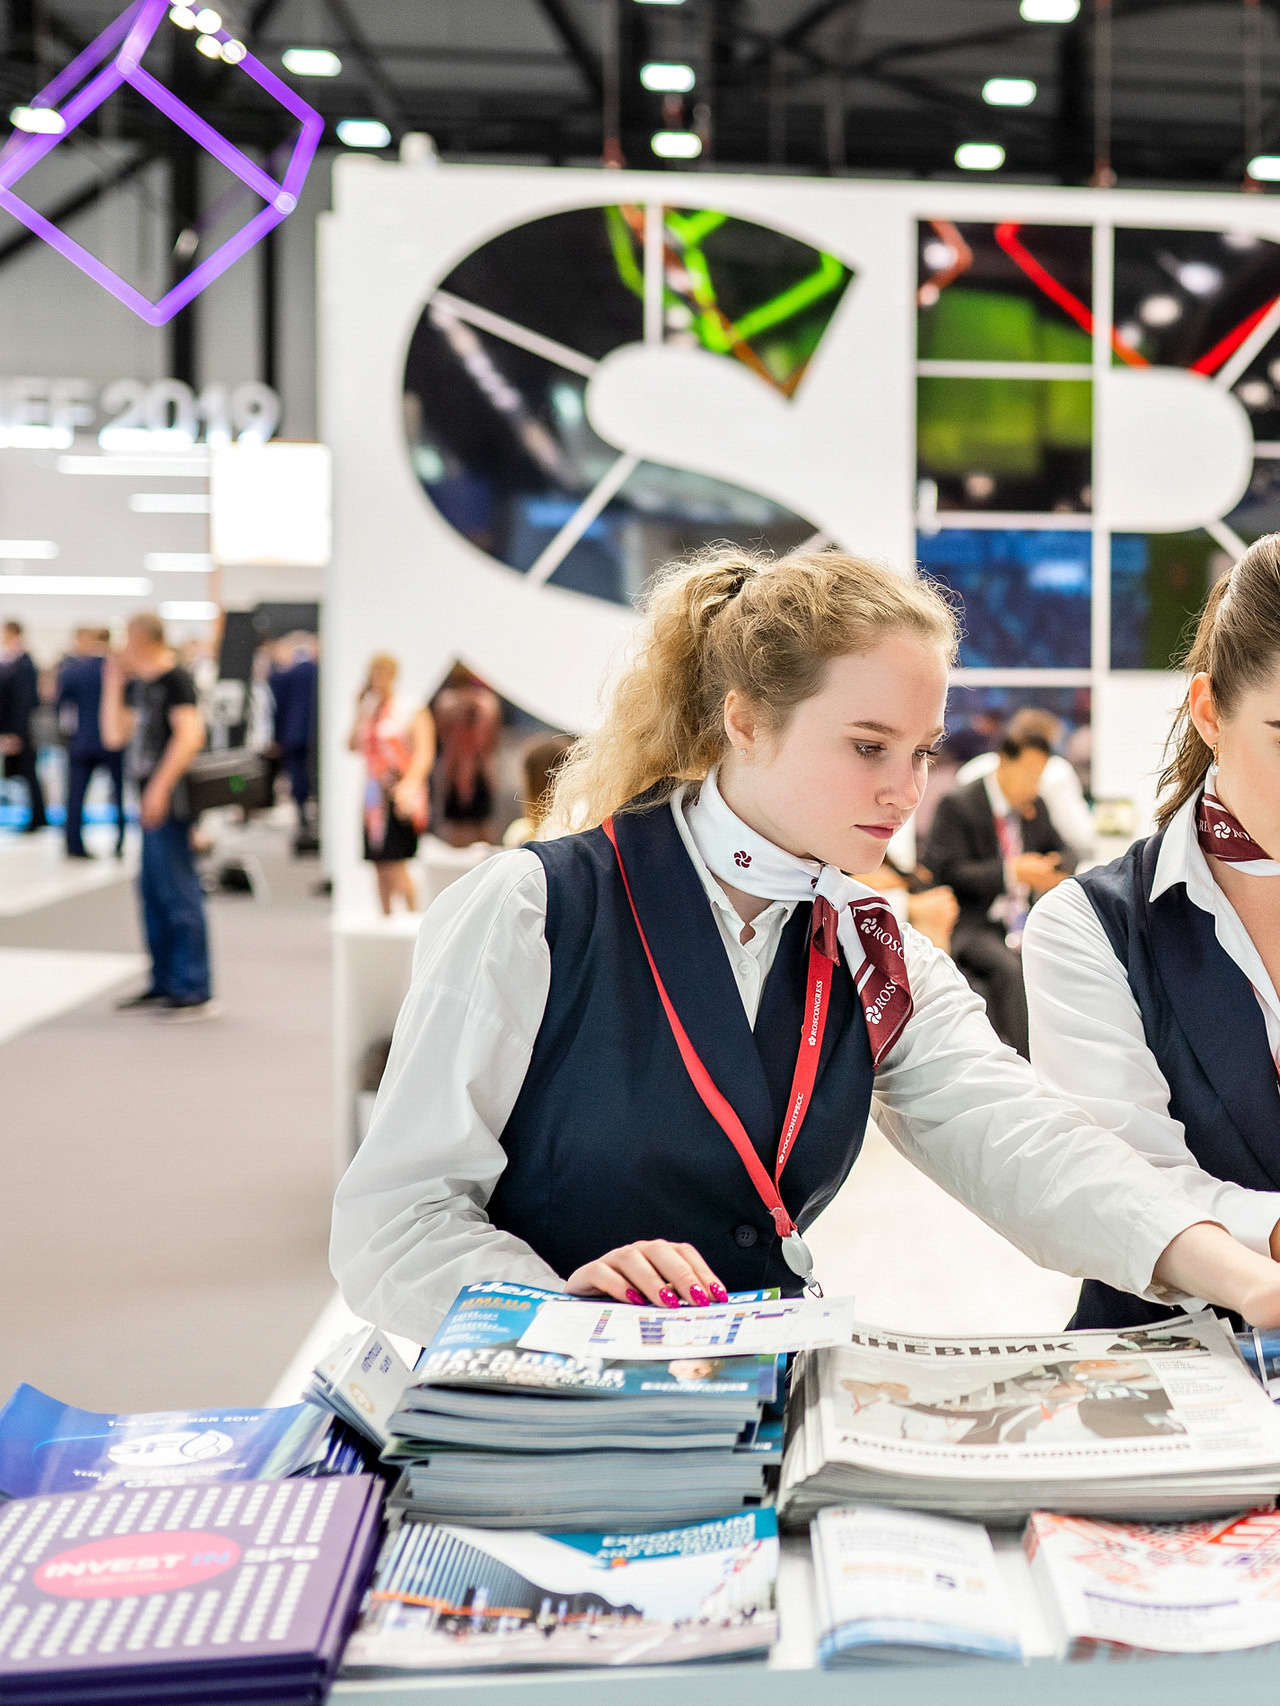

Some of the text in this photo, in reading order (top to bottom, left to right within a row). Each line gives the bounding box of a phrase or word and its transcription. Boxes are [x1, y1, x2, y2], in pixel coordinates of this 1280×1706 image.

[98, 377, 282, 450] 2019
[810, 980, 823, 1037] ROSCONGRESS
[781, 1092, 804, 1154] РОСКОНГРЕСС
[44, 1546, 320, 1578] INVEST IN SPB
